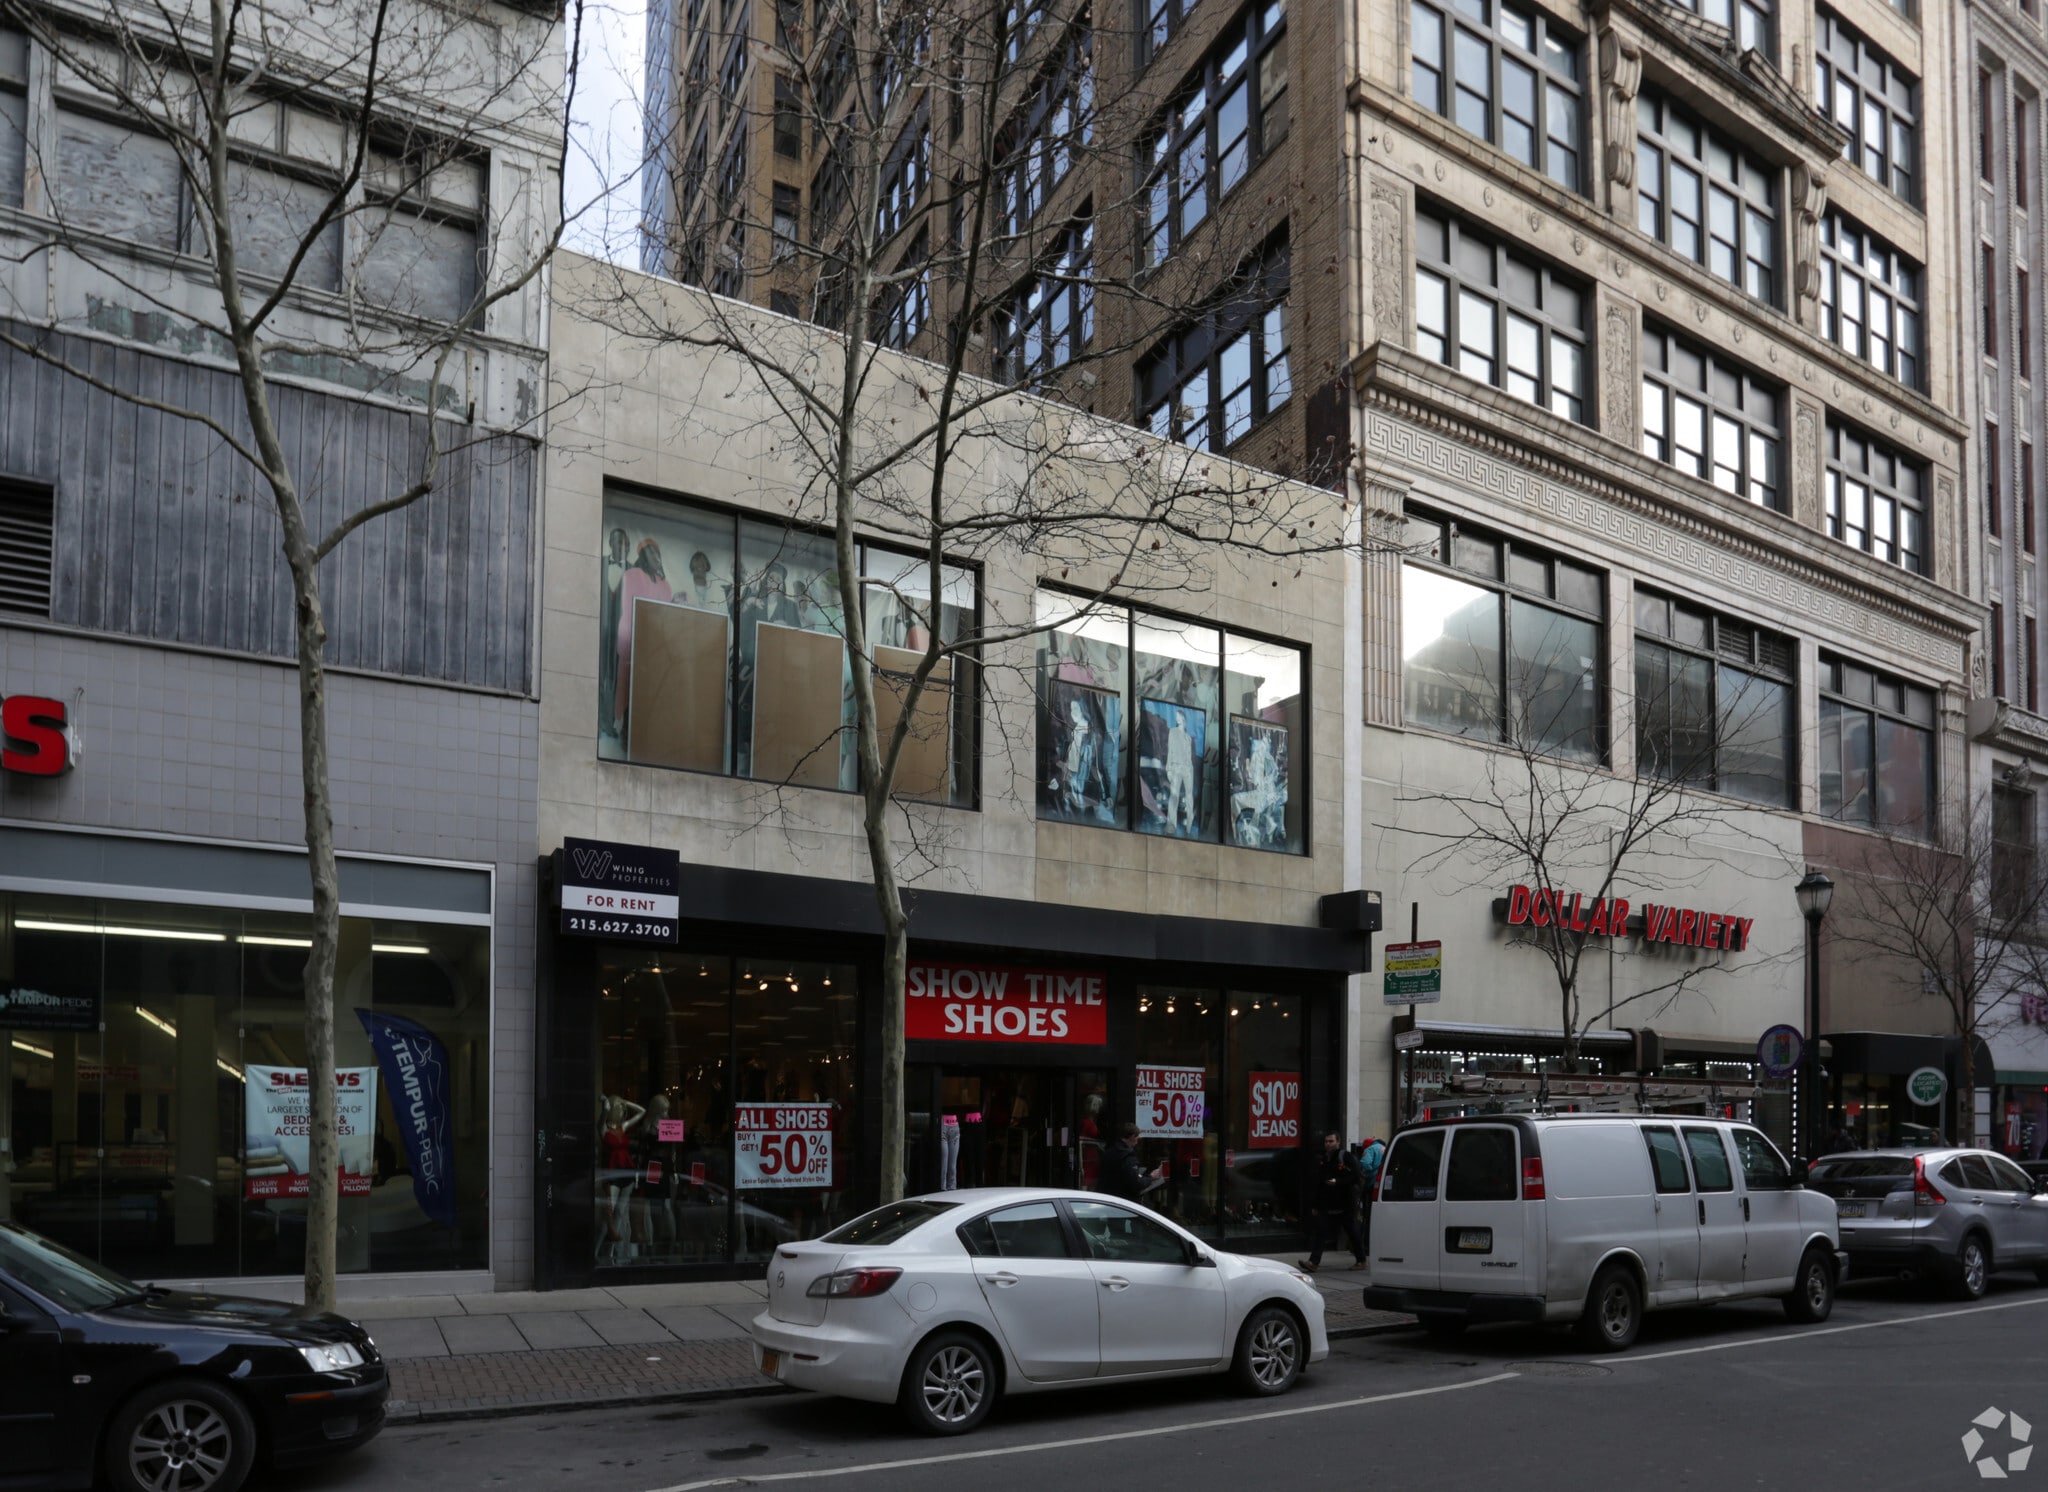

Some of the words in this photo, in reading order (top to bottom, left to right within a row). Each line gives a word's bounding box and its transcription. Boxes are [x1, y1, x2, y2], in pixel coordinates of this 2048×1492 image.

[612, 864, 645, 875] WINIG
[612, 874, 671, 887] PROPERTIES
[587, 895, 614, 907] FOR
[621, 898, 655, 911] RENT
[1508, 885, 1629, 937] DOLLAR
[1645, 903, 1753, 951] VARIETY
[570, 918, 670, 937] 215.627.3700
[909, 966, 1009, 1001] SHOW
[1023, 973, 1103, 1006] TIME
[944, 1003, 1068, 1038] SHOES
[1404, 1056, 1445, 1070] CHOOL
[270, 1072, 361, 1086] SLEYS
[1137, 1071, 1159, 1088] ALL
[1163, 1071, 1202, 1089] SHOES
[267, 1104, 303, 1114] LARGEST
[738, 1109, 770, 1129] ALL
[774, 1109, 828, 1129] SHOES
[1186, 1114, 1201, 1128] OFF
[274, 1126, 355, 1136] ACCESES!
[1252, 1119, 1298, 1138] JEANS
[737, 1133, 751, 1141] BUY
[741, 1144, 755, 1152] GET
[808, 1158, 828, 1174] OFF
[252, 1186, 278, 1194] SHEETS
